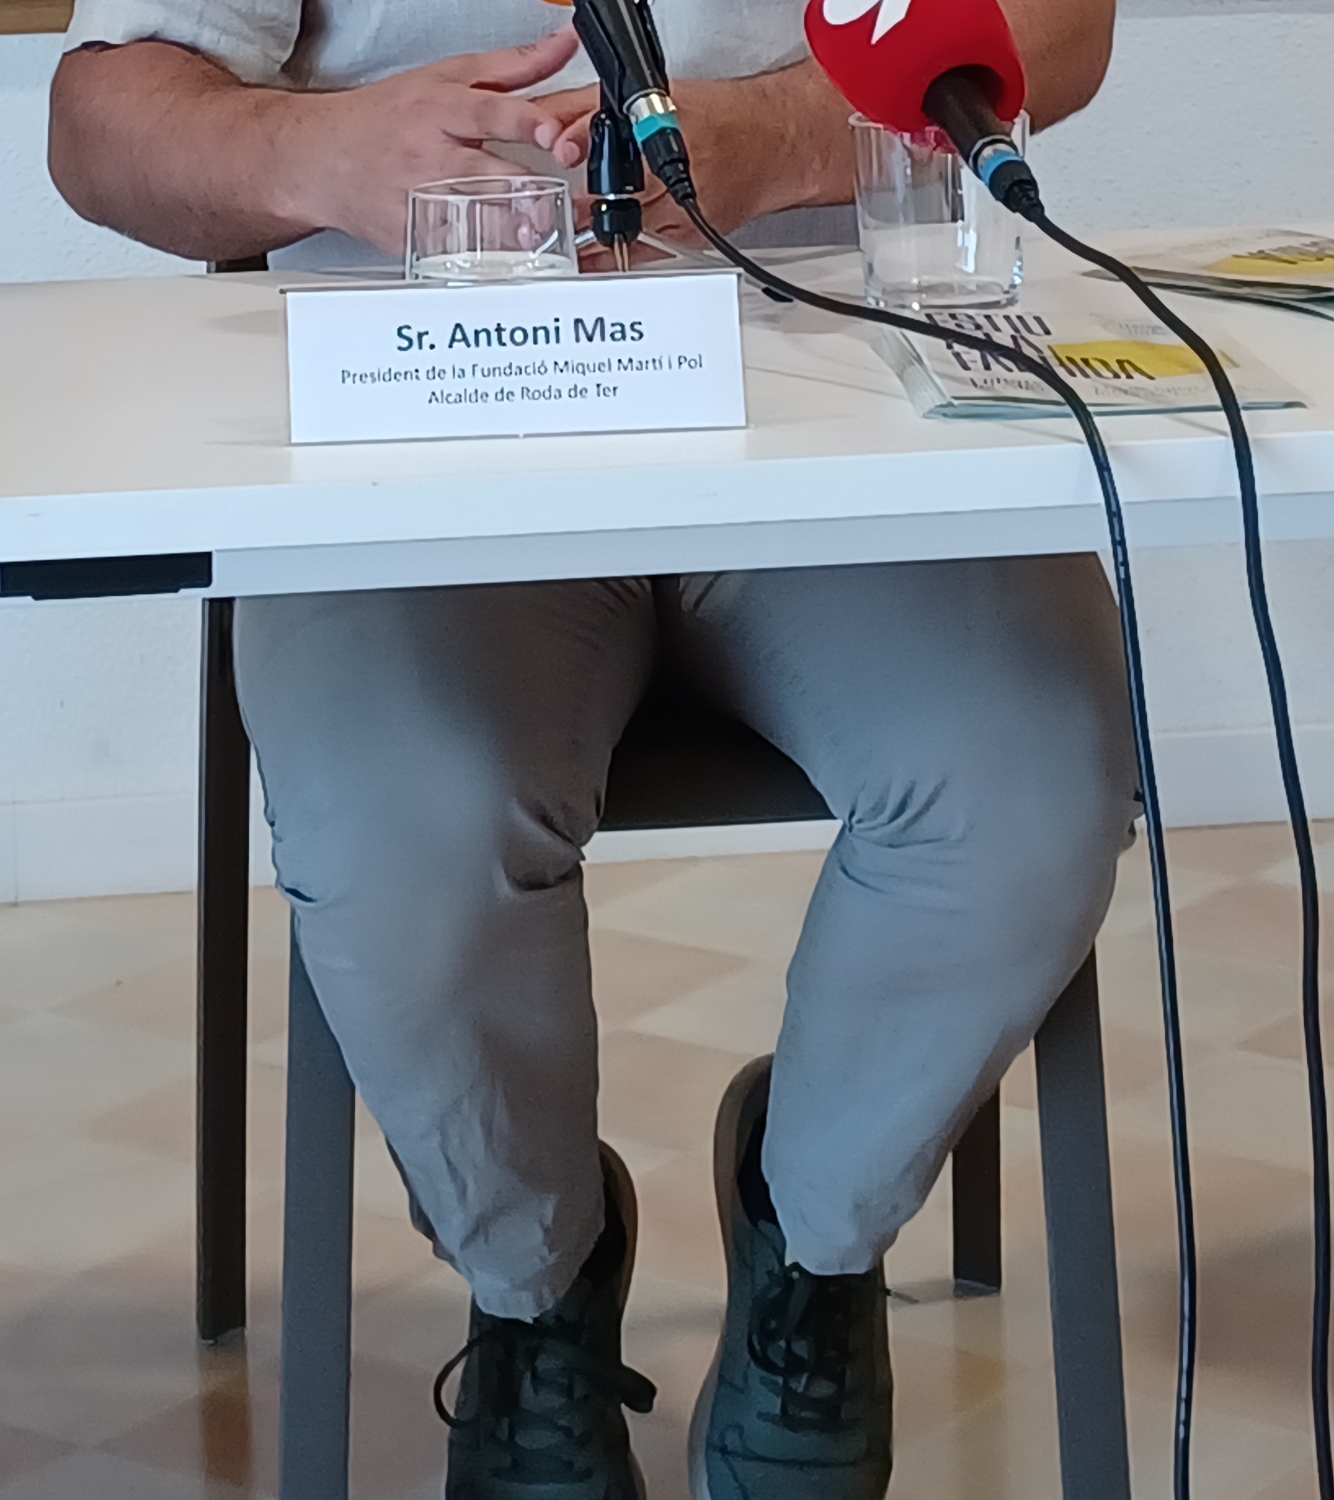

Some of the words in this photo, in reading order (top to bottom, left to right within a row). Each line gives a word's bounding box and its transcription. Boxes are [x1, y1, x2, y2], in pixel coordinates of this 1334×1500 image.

[396, 324, 436, 351] Sr.
[448, 317, 561, 349] Antoni
[573, 316, 644, 344] Mas
[341, 367, 421, 385] President
[426, 365, 447, 381] de
[452, 364, 466, 380] la
[471, 360, 548, 379] Fundació
[553, 357, 612, 377] Miquel
[617, 355, 663, 372] Martí
[677, 353, 703, 370] Pol
[428, 387, 489, 405] Alcalde
[494, 386, 515, 402] de
[520, 384, 562, 401] Roda
[568, 383, 588, 399] de
[596, 382, 619, 398] Ter
